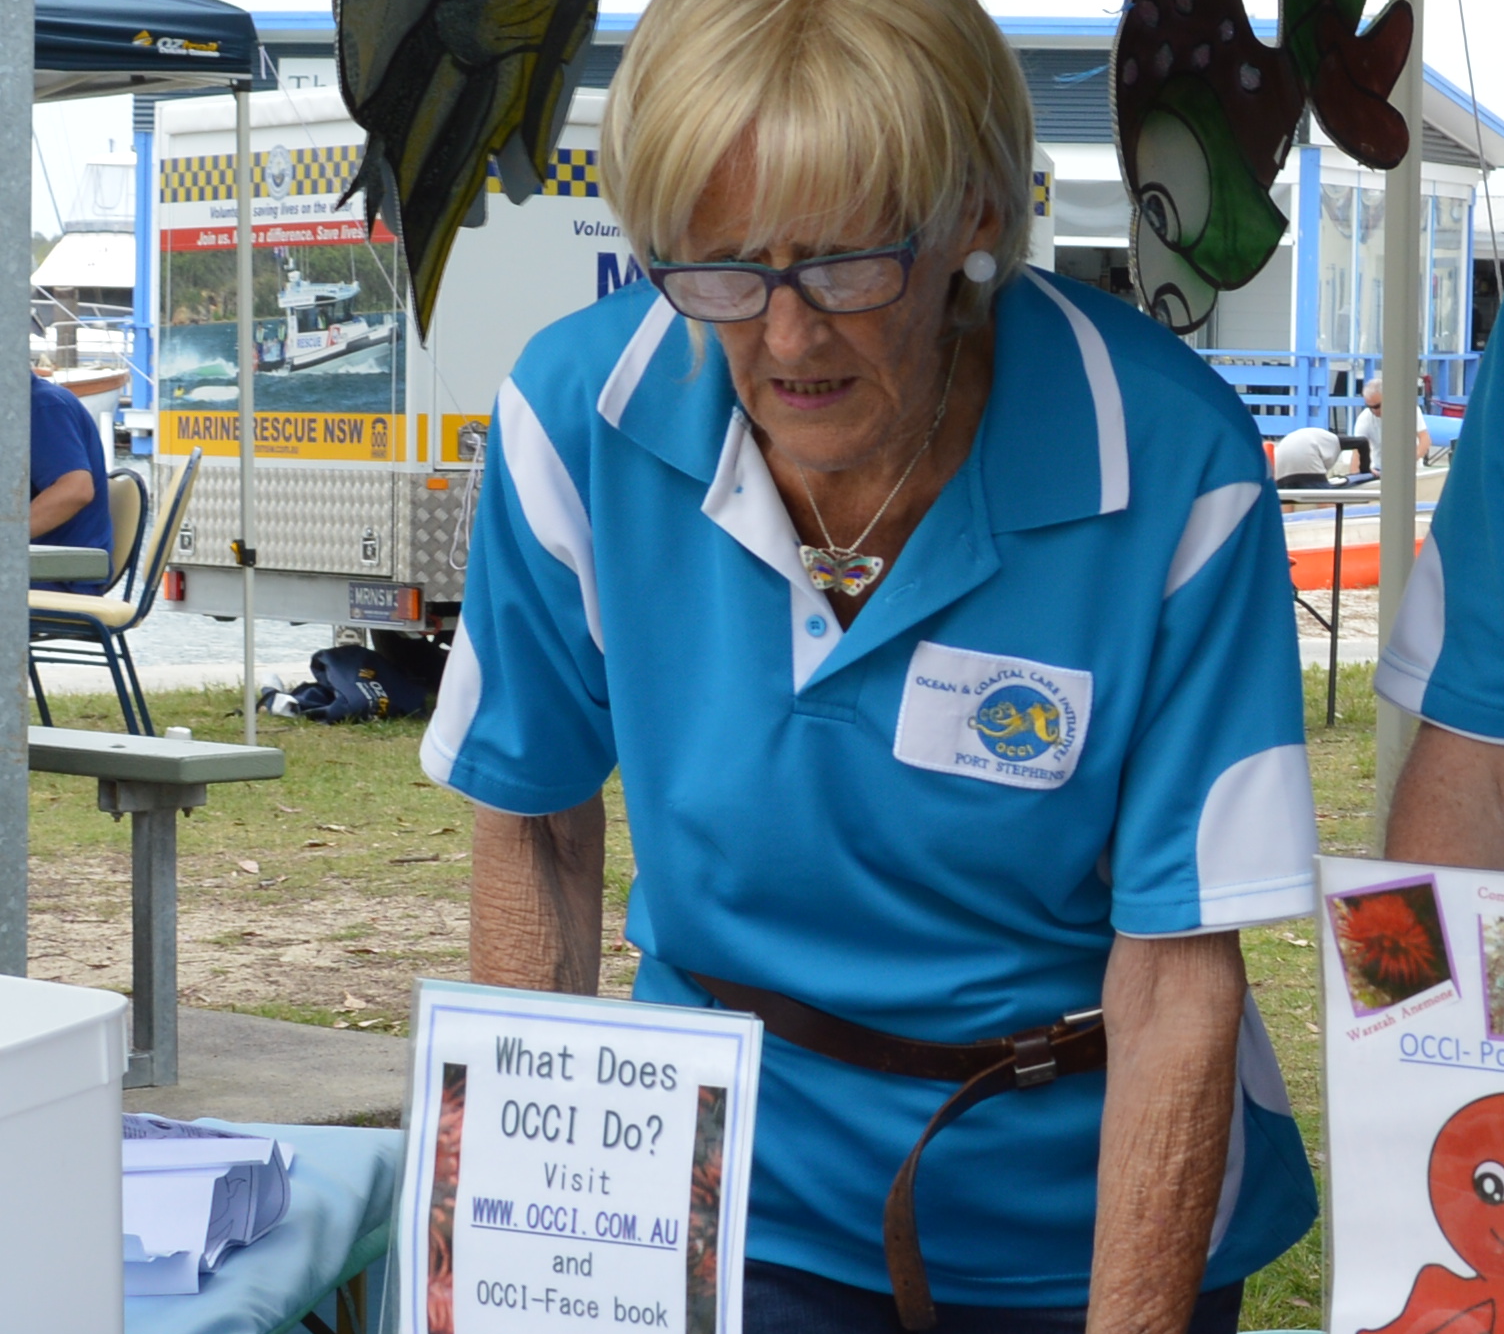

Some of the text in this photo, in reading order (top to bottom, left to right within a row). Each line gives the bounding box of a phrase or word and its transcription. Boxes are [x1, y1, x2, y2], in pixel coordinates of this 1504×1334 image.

[197, 231, 216, 246] Join
[266, 226, 312, 243] difference.
[316, 226, 338, 241] Save
[297, 337, 322, 349] RESCUE
[177, 416, 239, 440] MARINE
[324, 418, 364, 444] NSW
[916, 675, 956, 693] OCEAN
[962, 685, 971, 695] &
[974, 669, 1025, 696] COASTAL
[1030, 671, 1061, 696] CARE
[996, 742, 1034, 756] OCCI
[954, 752, 1065, 781] PORT STEPHENS
[1346, 987, 1454, 1043] Waratah Anemone
[1400, 1032, 1470, 1063] OCCI-
[496, 1035, 678, 1091] What Does
[501, 1099, 664, 1156] OCCI Do?
[544, 1161, 611, 1196] Visit
[552, 1252, 593, 1278] and
[477, 1279, 669, 1328] OCCI-Face book
